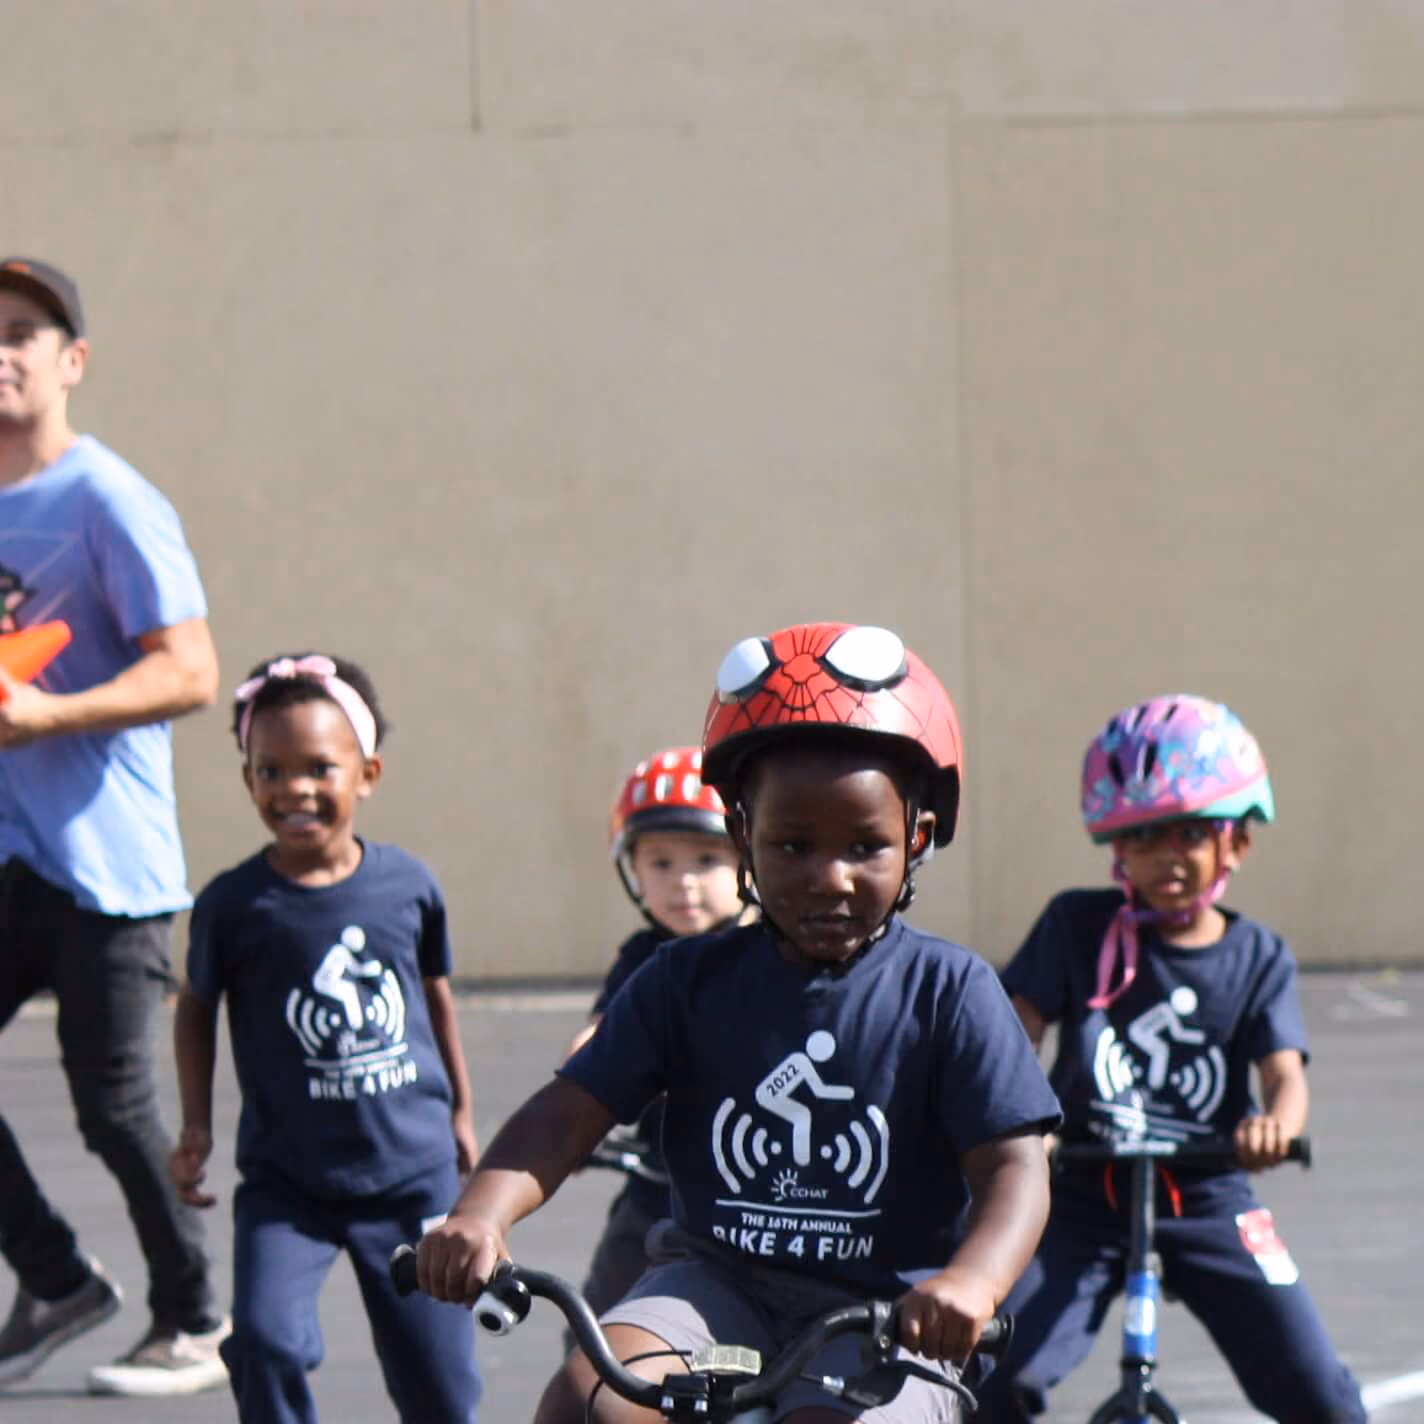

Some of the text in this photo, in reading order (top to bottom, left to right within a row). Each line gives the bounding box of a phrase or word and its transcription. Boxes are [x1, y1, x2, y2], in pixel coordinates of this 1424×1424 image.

[766, 1064, 800, 1098] 2022
[790, 1187, 829, 1200] CCHAT
[741, 1212, 853, 1234] THE 16TH ANNUAL
[787, 1234, 805, 1257] 4
[817, 1235, 874, 1261] FUN
